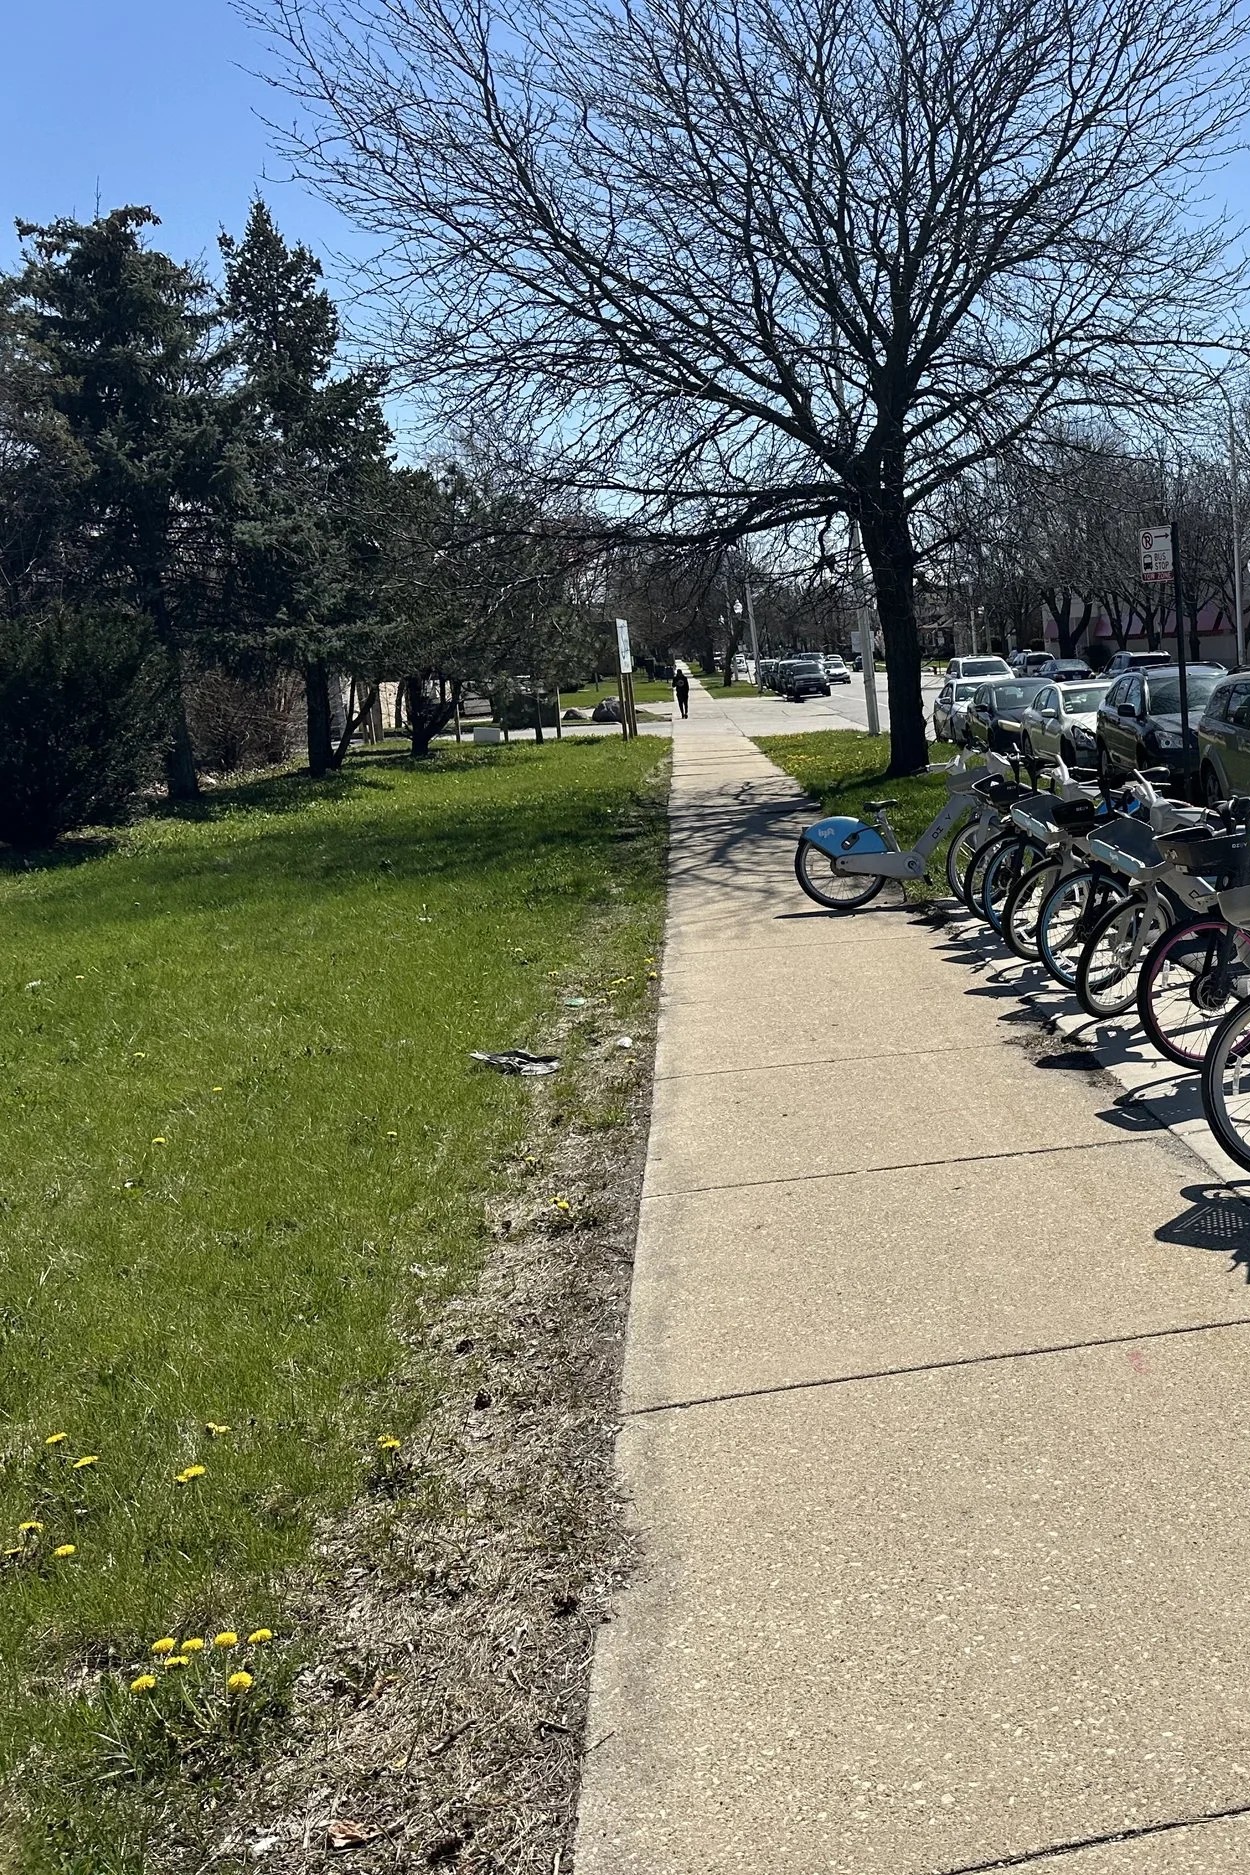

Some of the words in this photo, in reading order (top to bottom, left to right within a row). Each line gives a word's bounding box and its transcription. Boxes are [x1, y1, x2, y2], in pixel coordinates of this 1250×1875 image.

[1154, 552, 1166, 561] BUS
[1155, 562, 1169, 570] STOP
[818, 827, 835, 838] lyft
